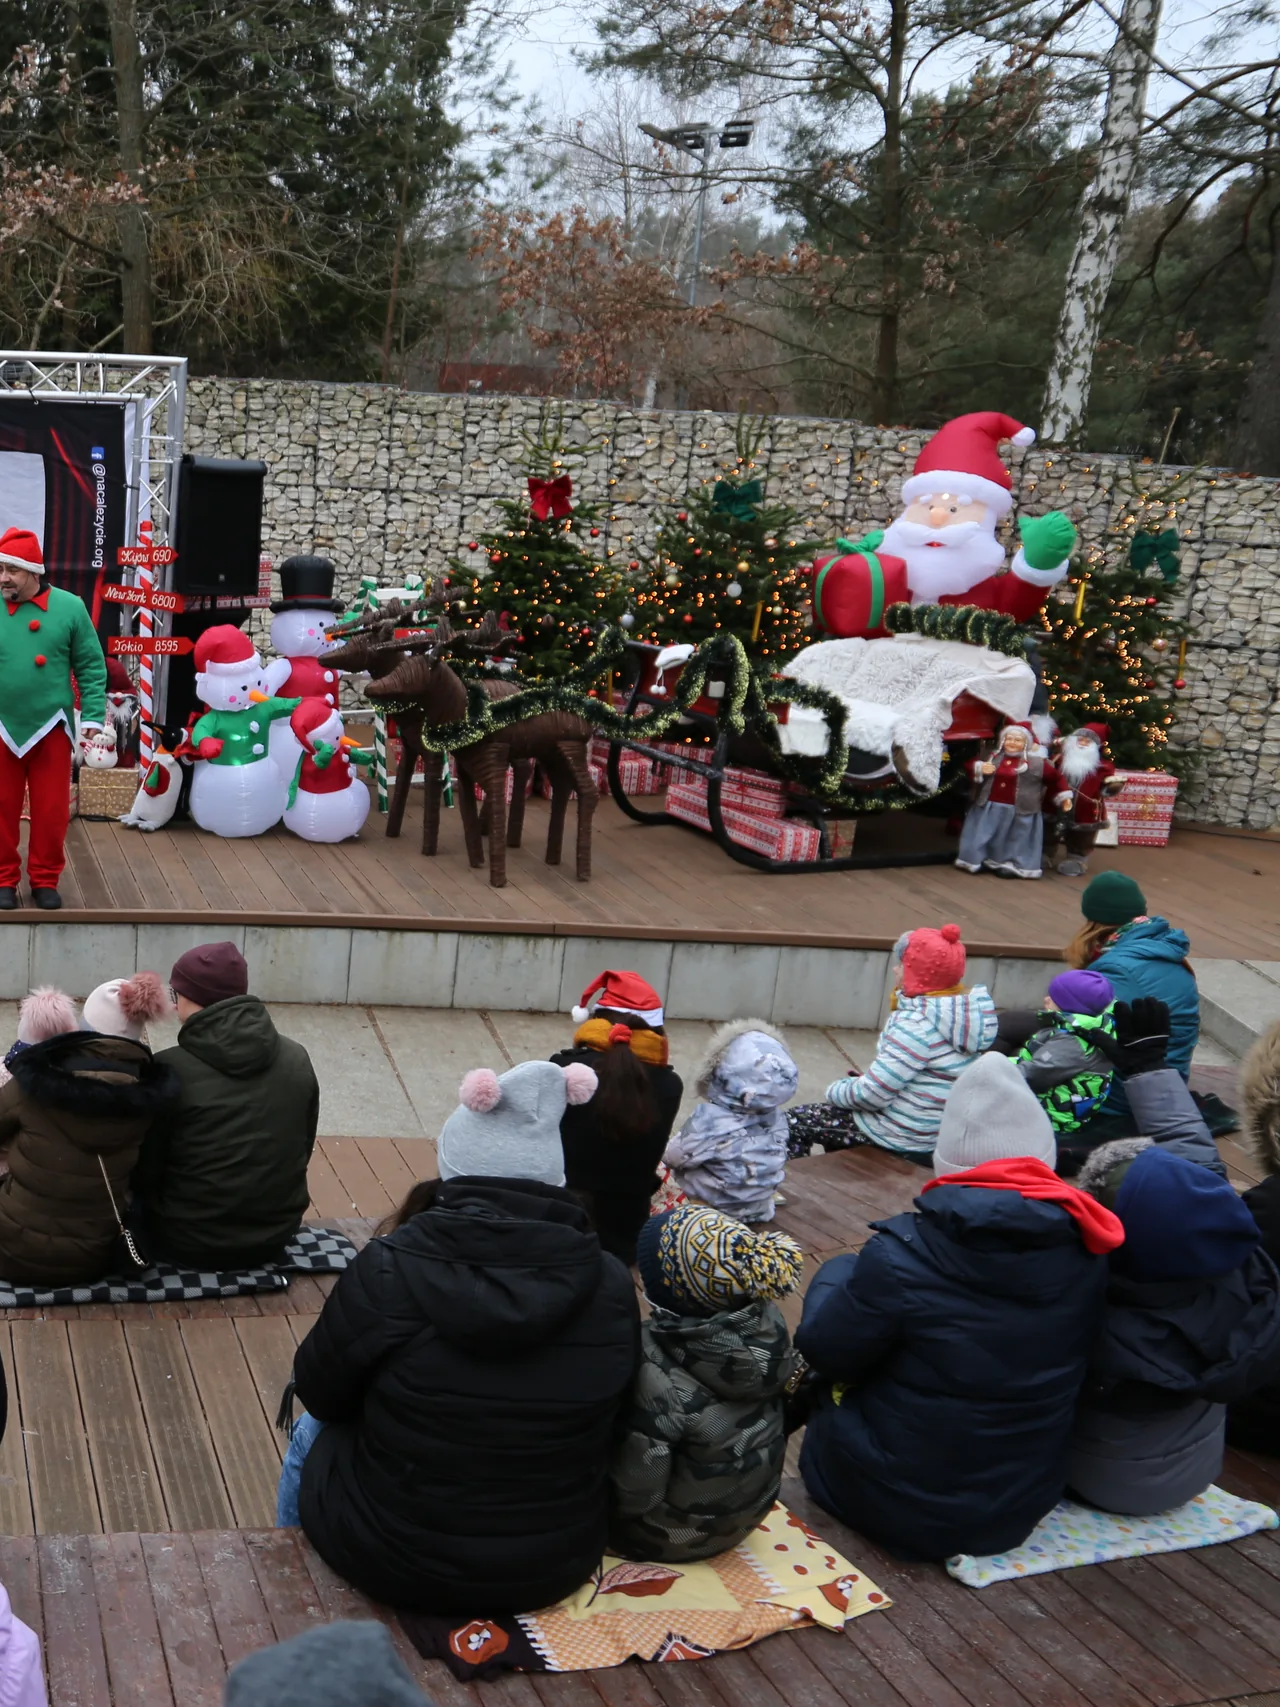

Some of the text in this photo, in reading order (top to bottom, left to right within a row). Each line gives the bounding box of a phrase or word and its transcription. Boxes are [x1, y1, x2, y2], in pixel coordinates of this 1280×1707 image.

[92, 463, 107, 568] @nacalezycie.org
[152, 549, 172, 562] 690
[105, 586, 176, 609] New York 6800
[113, 640, 178, 652] Tokio 8595
